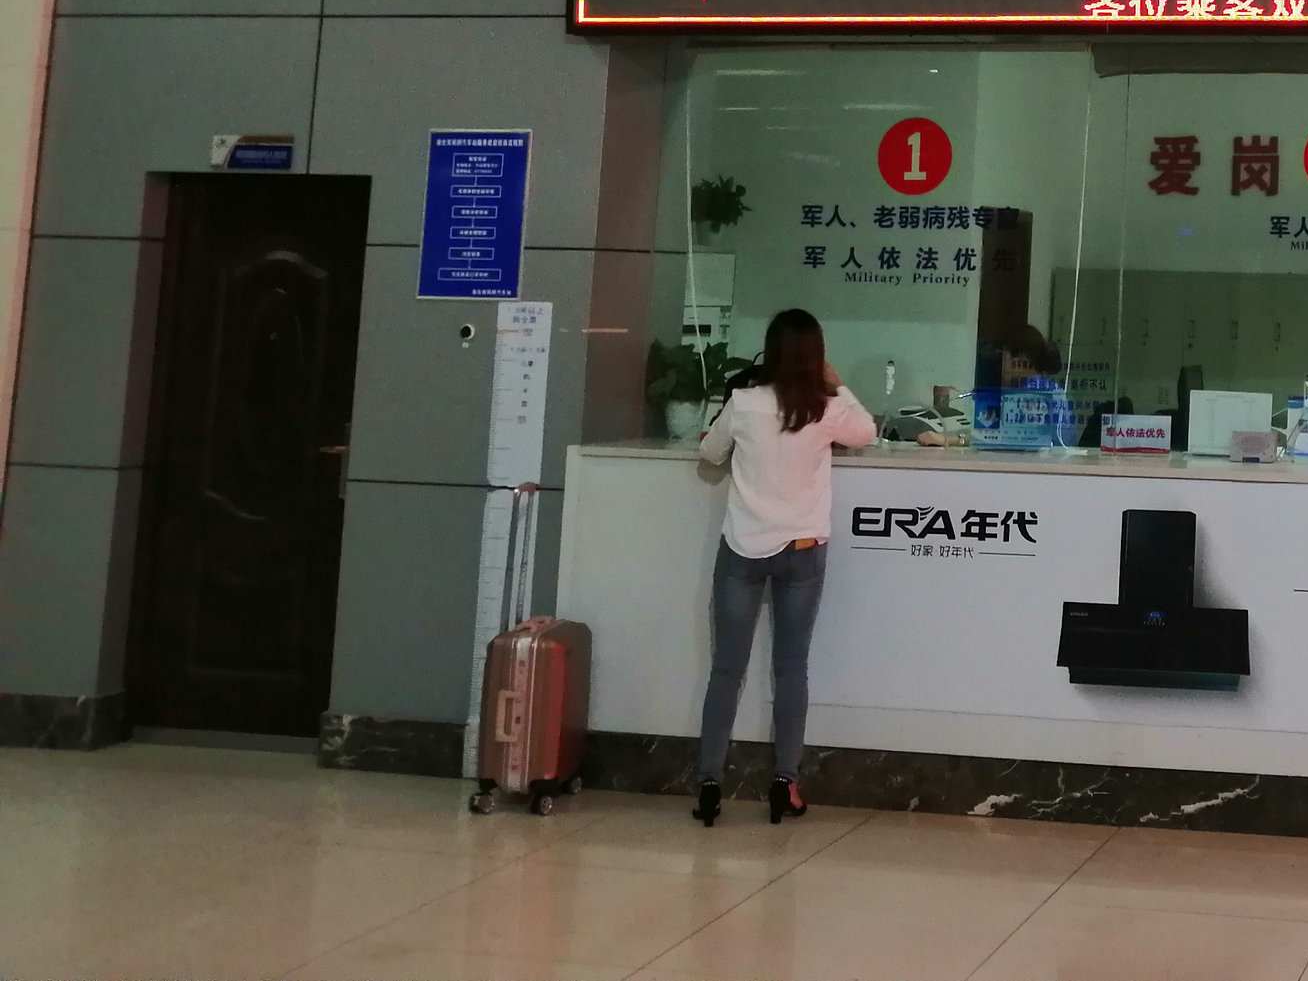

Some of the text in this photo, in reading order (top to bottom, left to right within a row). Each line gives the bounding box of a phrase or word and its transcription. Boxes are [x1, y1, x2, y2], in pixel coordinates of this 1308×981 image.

[904, 132, 926, 180] 1
[845, 272, 969, 287] Military Priority
[1106, 427, 1166, 439] 军人依法优先
